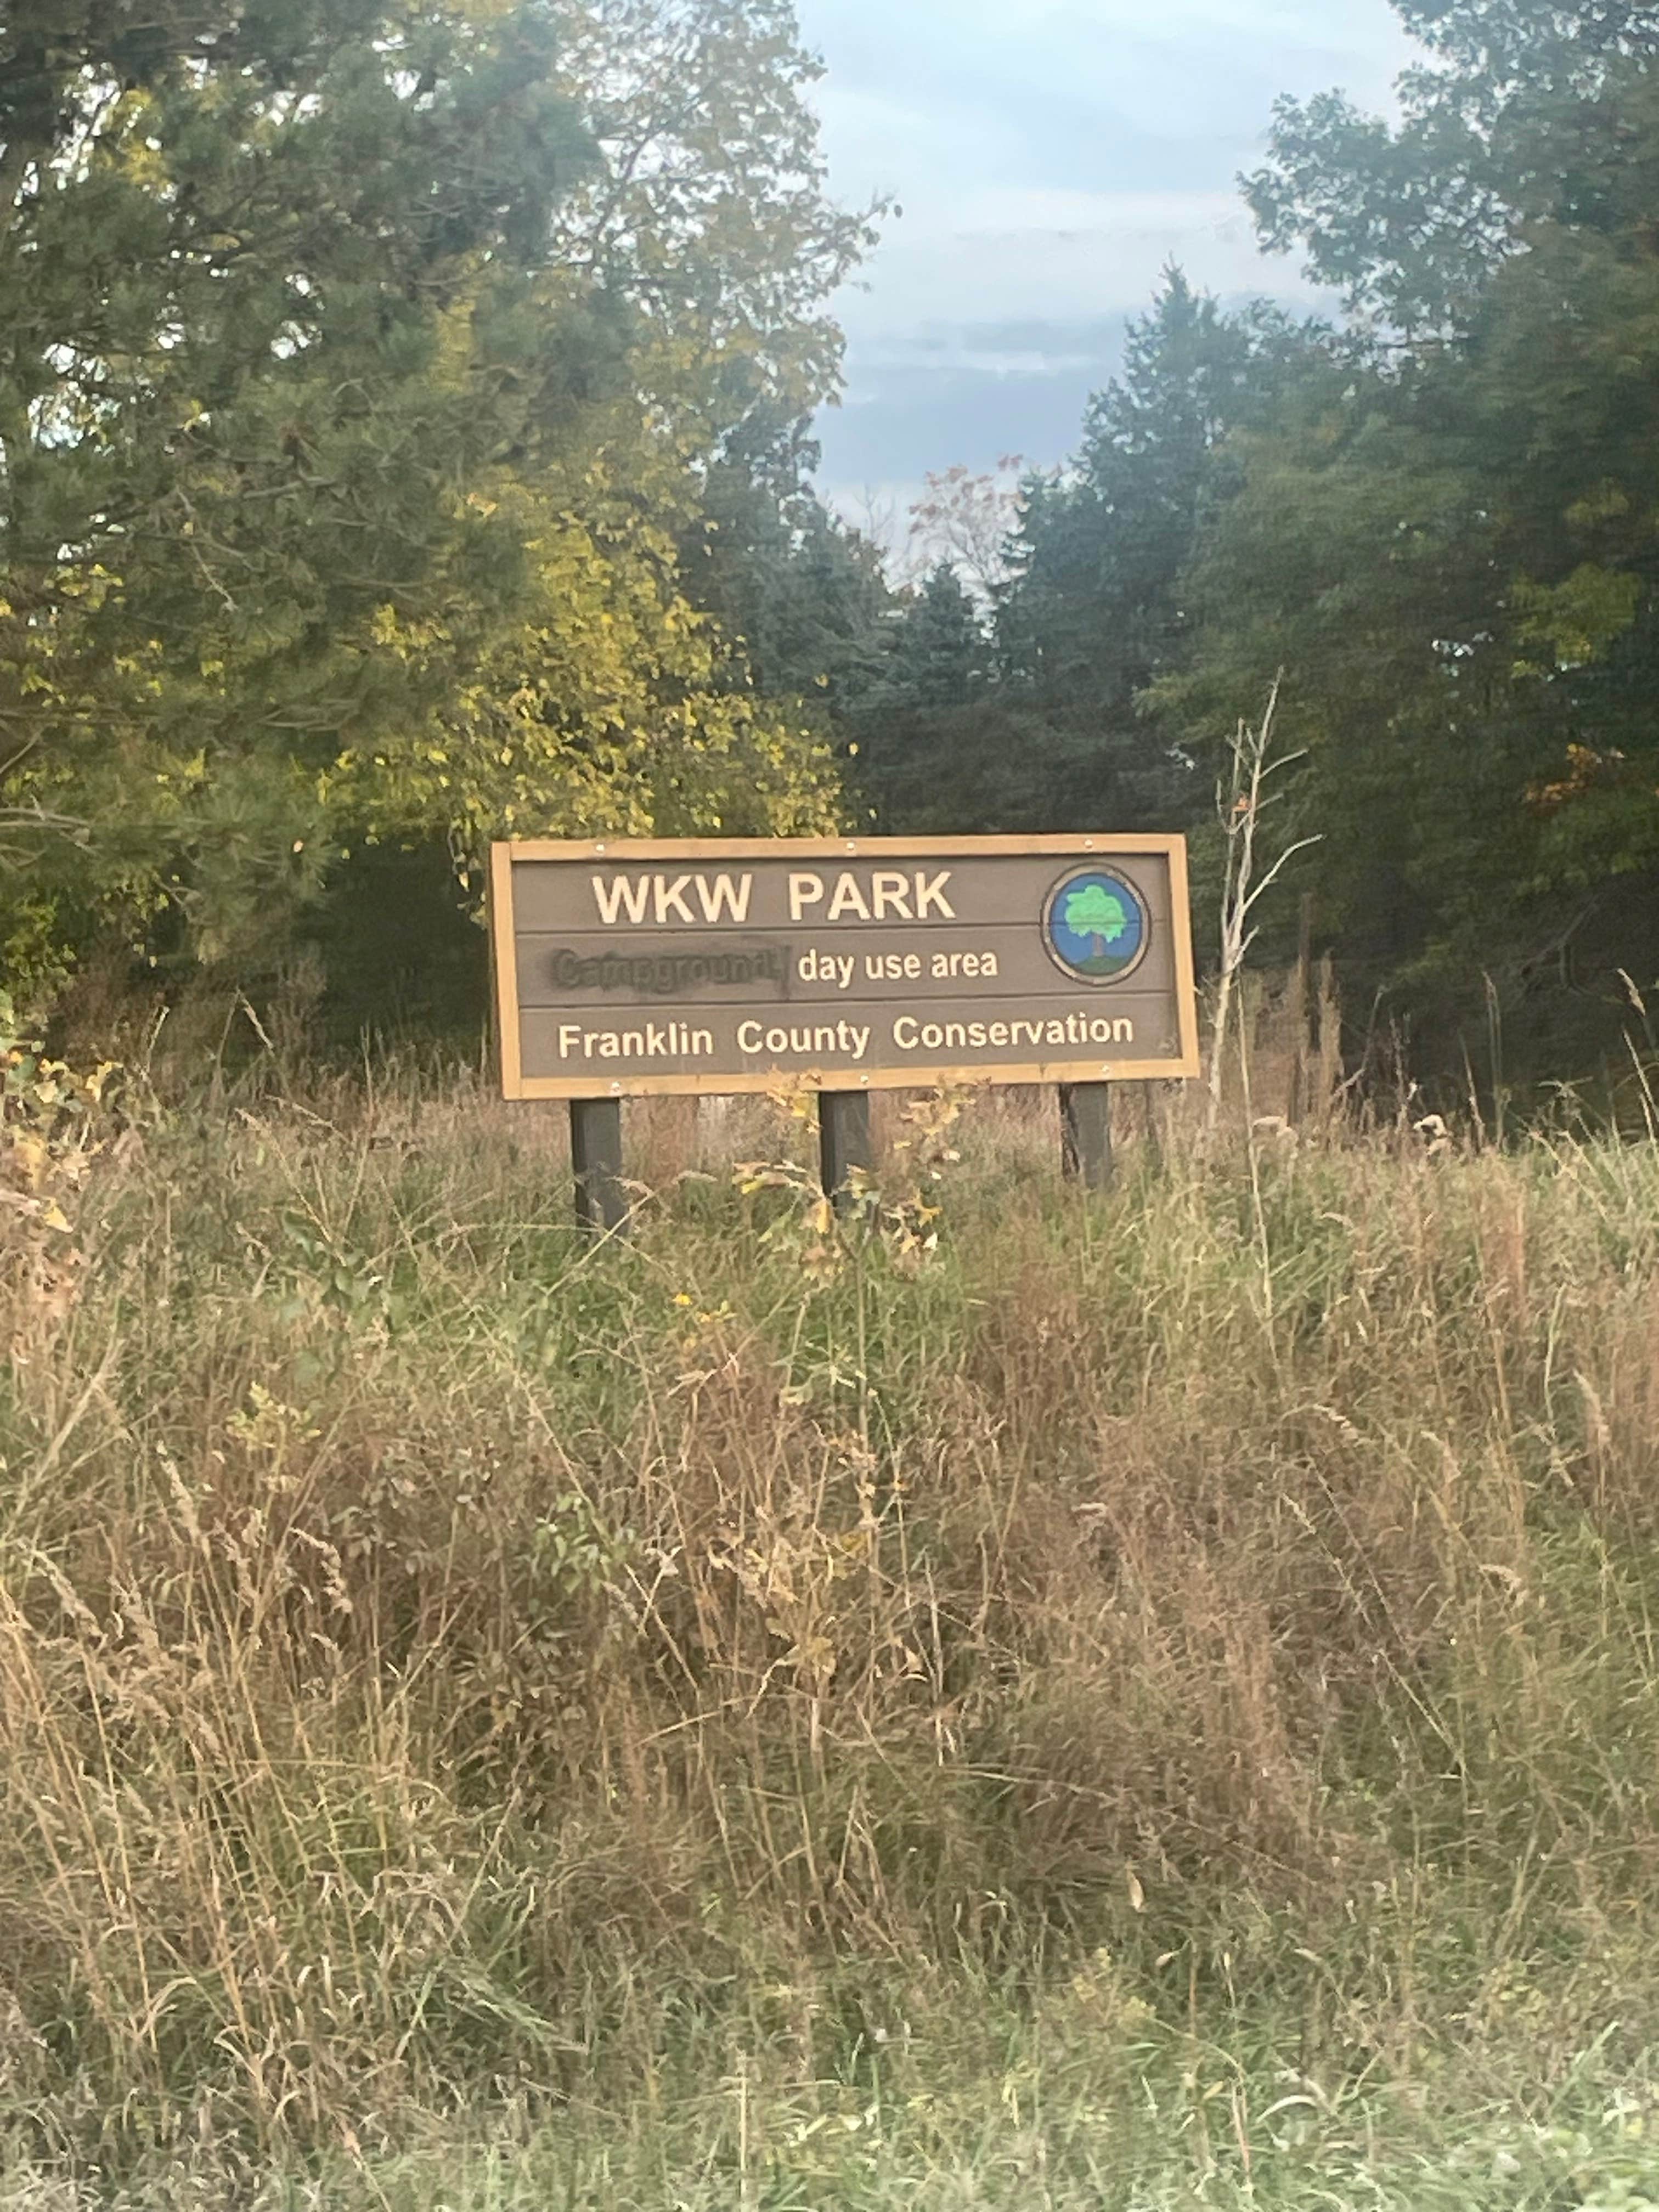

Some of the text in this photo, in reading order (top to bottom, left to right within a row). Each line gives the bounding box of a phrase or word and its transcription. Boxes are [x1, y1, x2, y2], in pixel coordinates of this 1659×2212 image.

[592, 871, 956, 924] WKW PARK
[798, 948, 855, 989] day
[865, 953, 921, 980] use
[931, 951, 998, 978] area
[558, 1011, 1133, 1059] Franklin County Conservation
